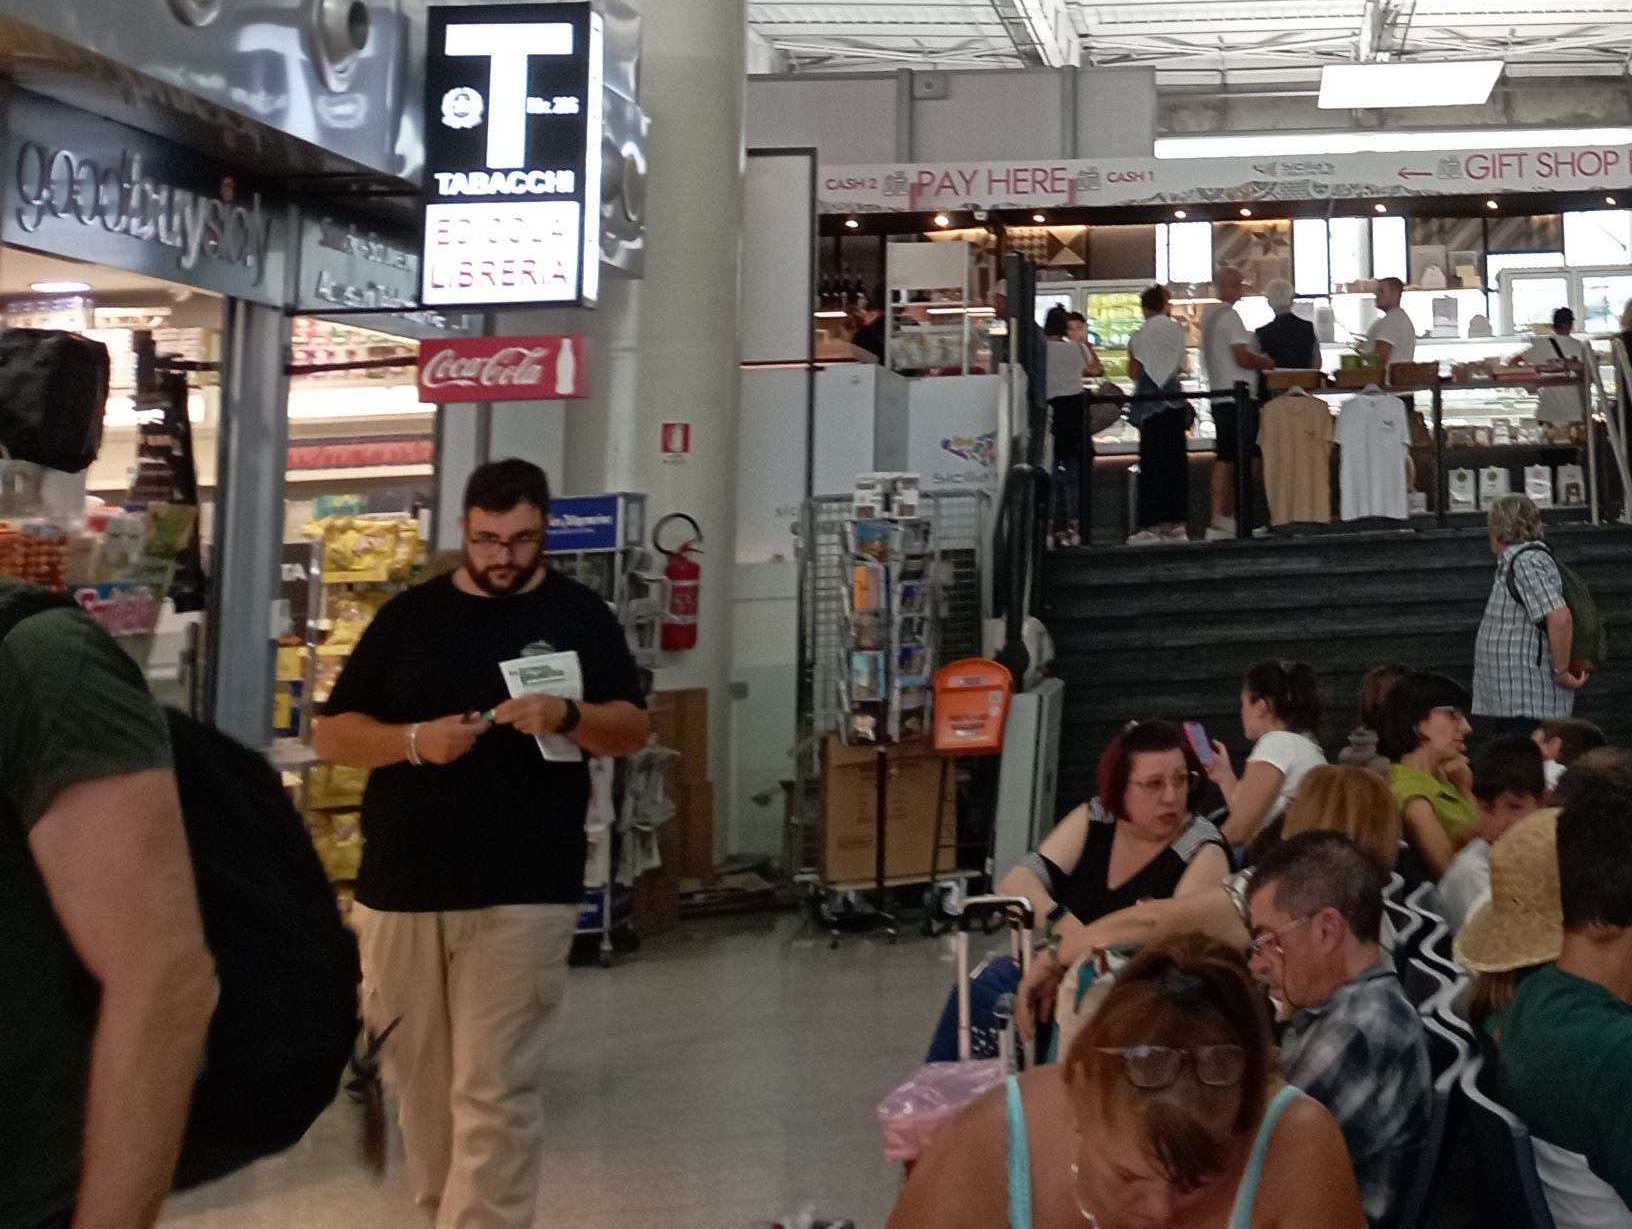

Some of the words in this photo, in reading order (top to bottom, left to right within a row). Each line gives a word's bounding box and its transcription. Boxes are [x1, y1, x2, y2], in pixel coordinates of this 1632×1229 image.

[445, 23, 574, 169] T
[1464, 153, 1528, 180] GIFT
[1535, 150, 1621, 178] SHOP
[434, 170, 575, 195] TABACCHI
[825, 177, 867, 190] CASH
[868, 177, 878, 190] 2
[917, 169, 979, 197] PAY
[987, 167, 1068, 195] HERE
[1106, 171, 1145, 183] CASH
[437, 217, 564, 245] EDICOLA
[432, 259, 568, 288] LIBRERIA
